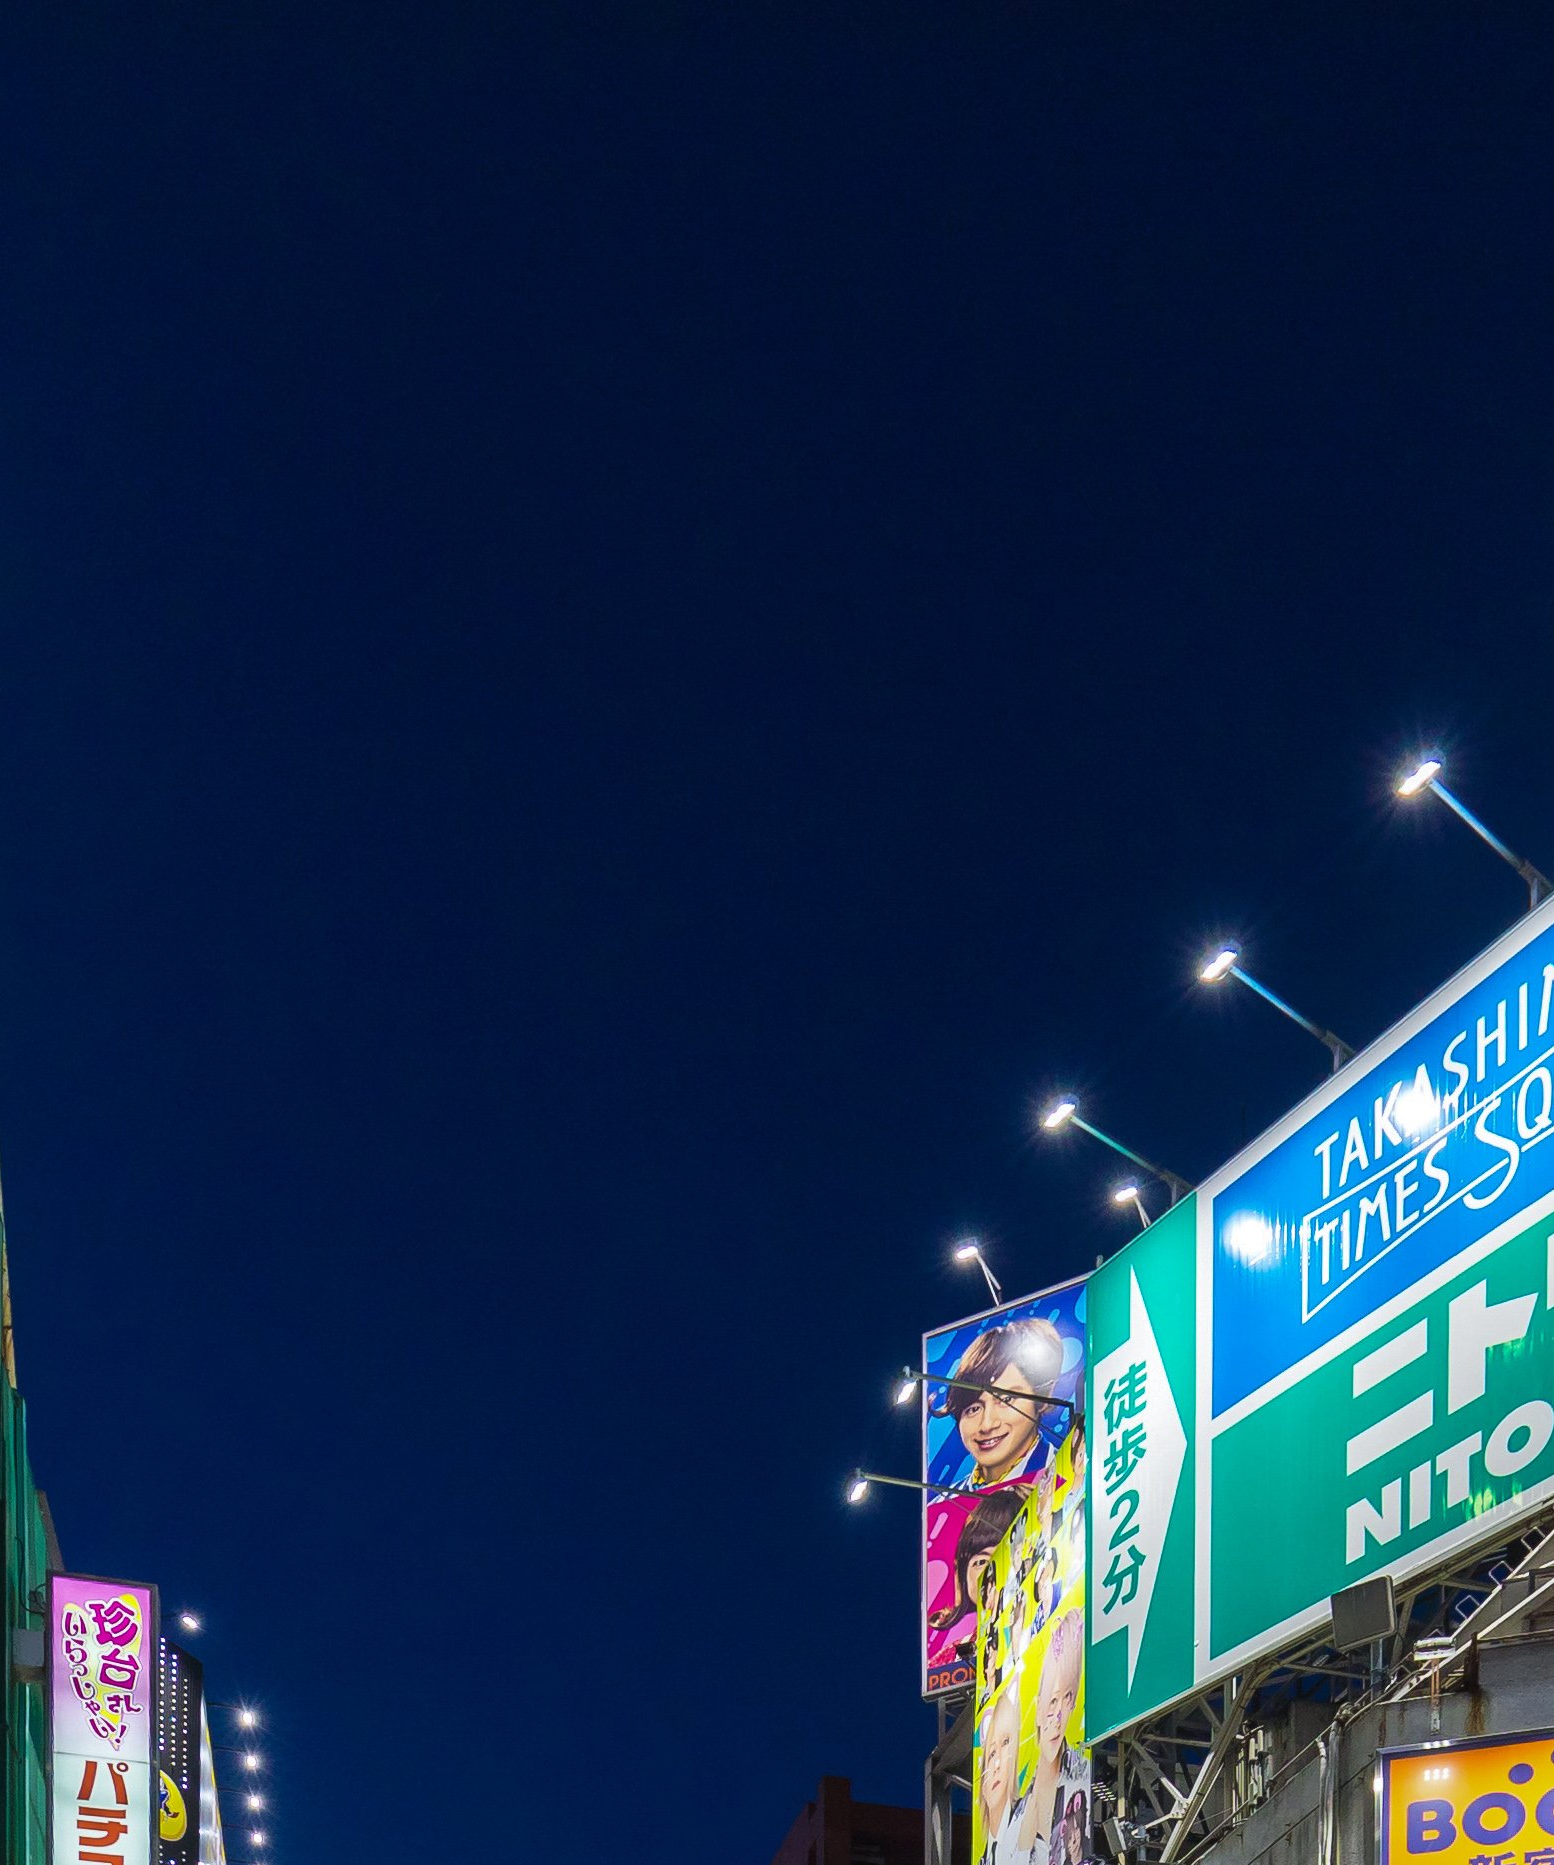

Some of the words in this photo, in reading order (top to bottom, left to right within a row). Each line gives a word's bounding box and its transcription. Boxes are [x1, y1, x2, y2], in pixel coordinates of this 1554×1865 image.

[1314, 1155, 1450, 1290] TIMES
[1101, 1360, 1148, 1615] 徒歩2分
